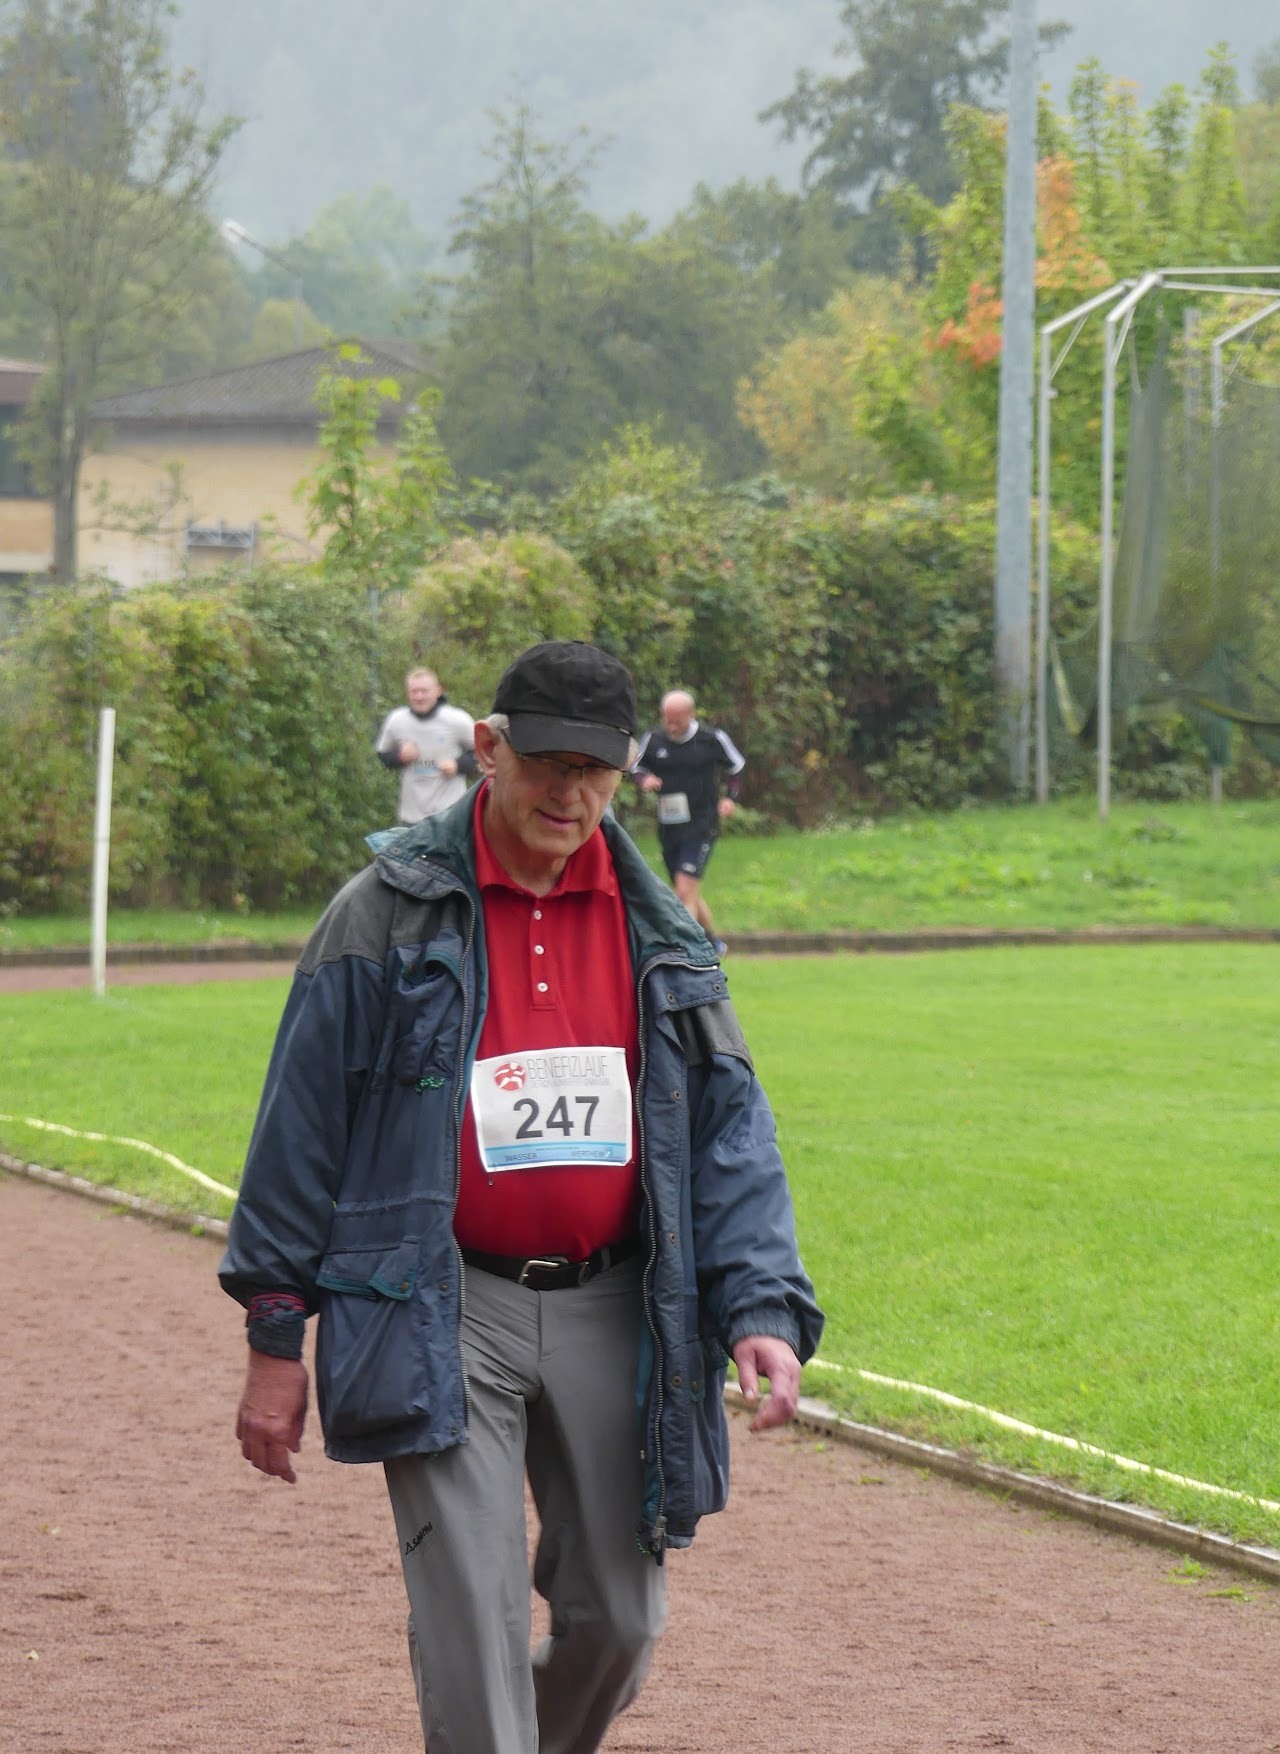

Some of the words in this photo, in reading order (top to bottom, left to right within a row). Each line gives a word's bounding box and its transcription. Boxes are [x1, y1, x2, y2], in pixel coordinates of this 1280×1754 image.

[527, 1055, 608, 1080] BENEFIZLAUF
[513, 1095, 600, 1140] 247
[505, 1152, 537, 1162] WASSER
[570, 1150, 605, 1158] WERTHEIM
